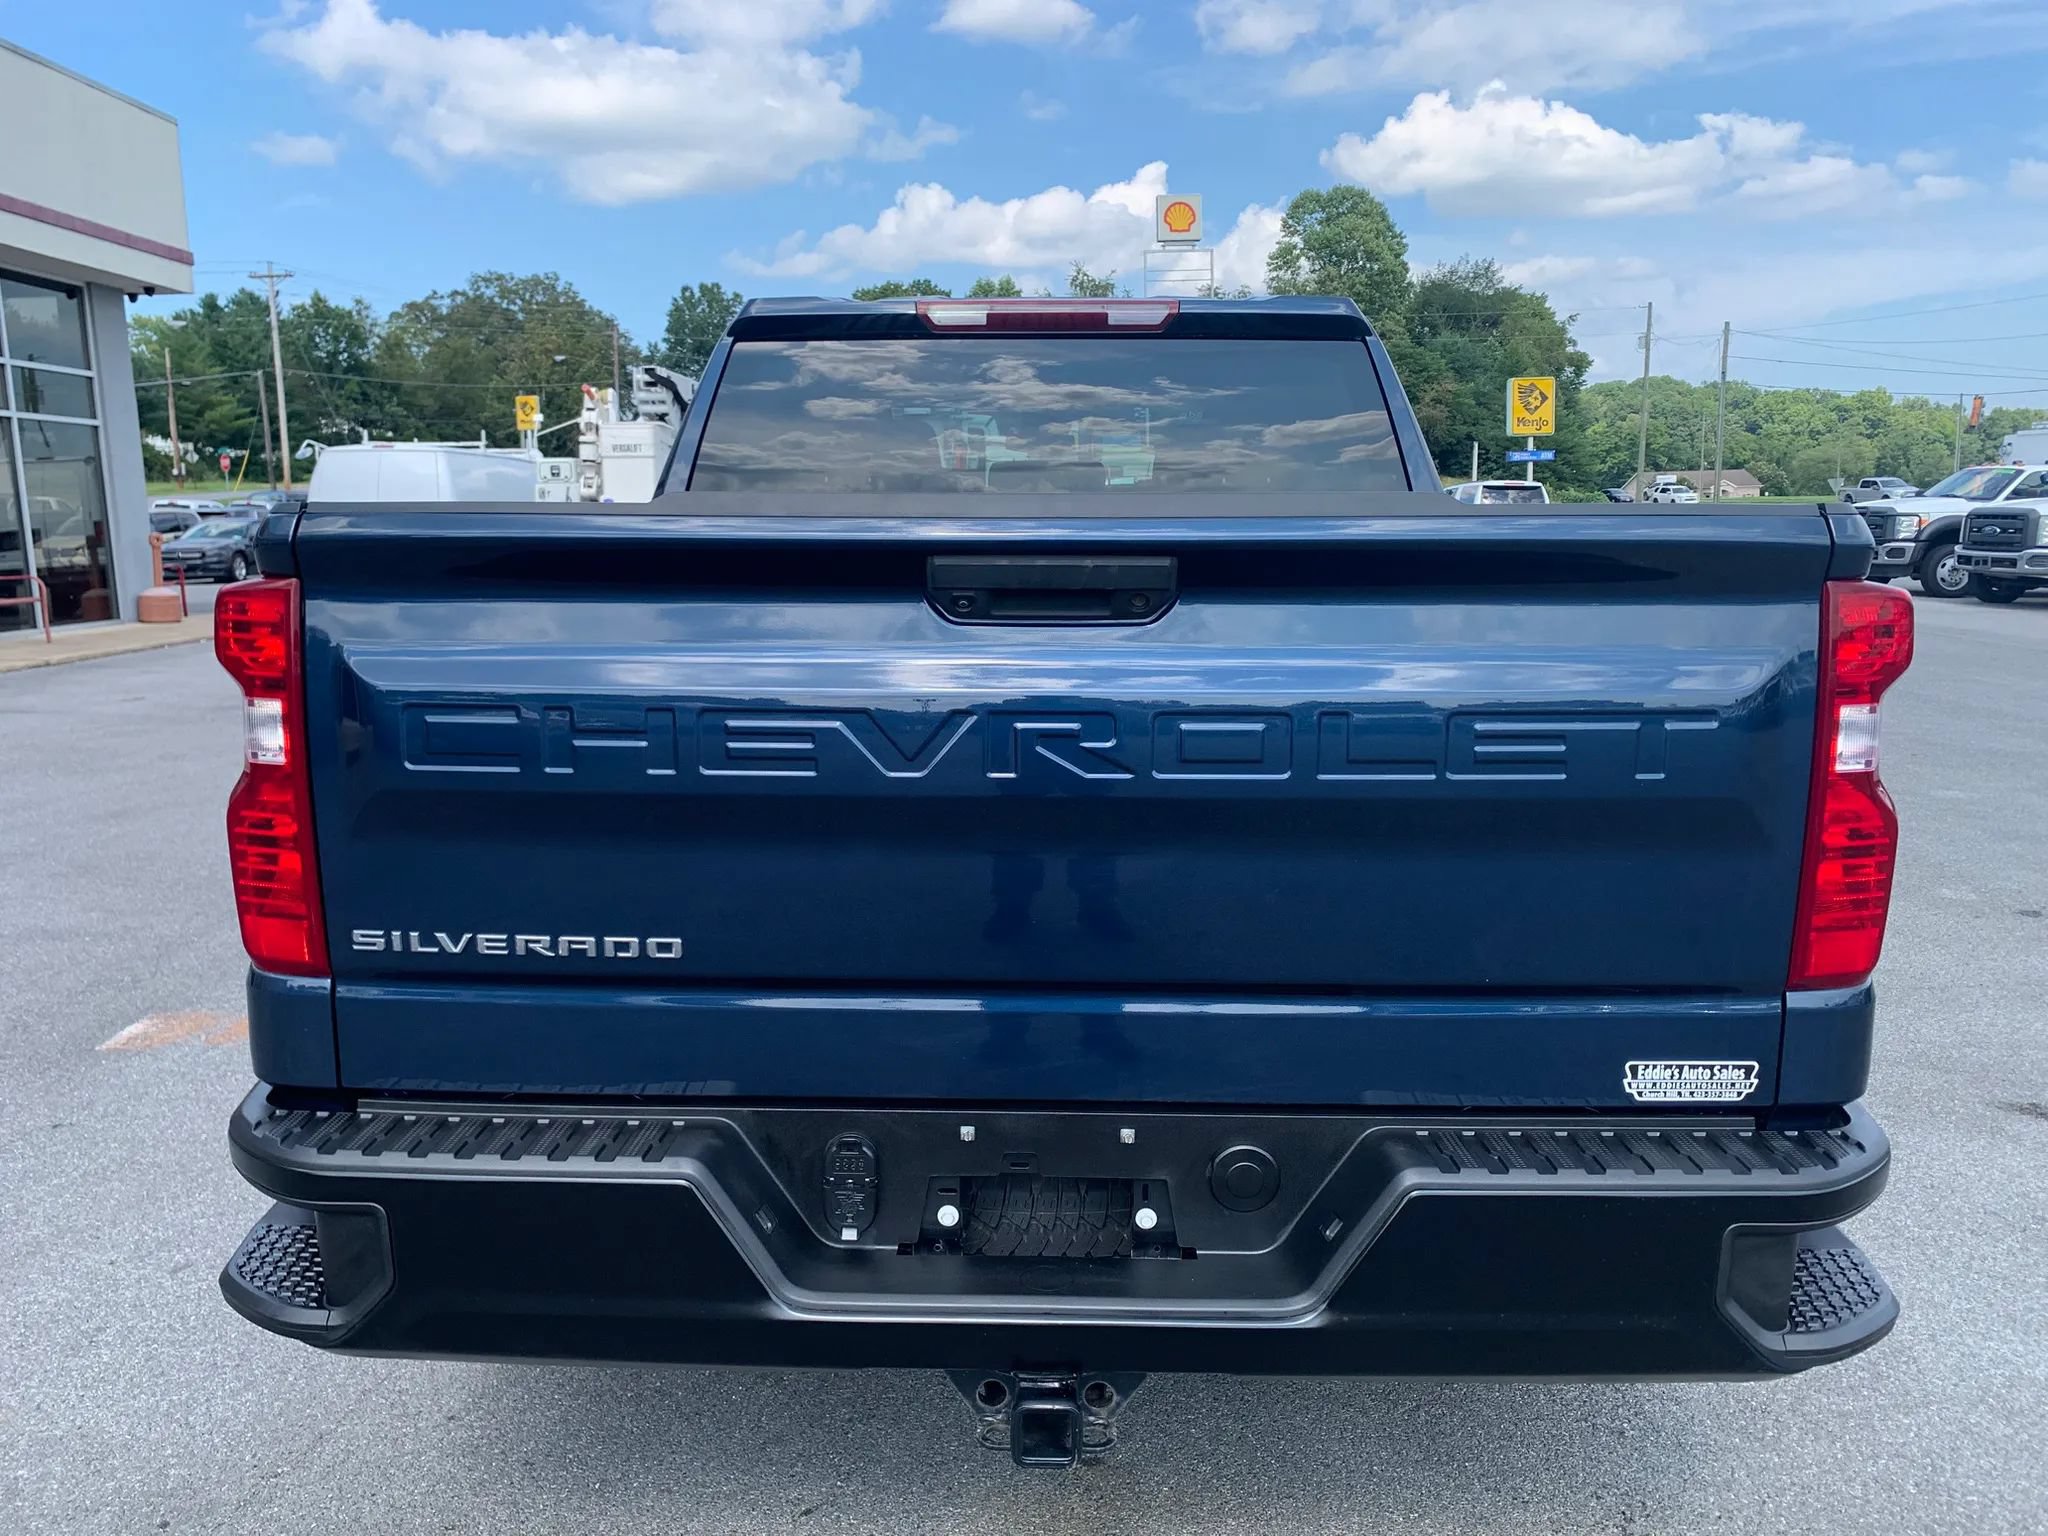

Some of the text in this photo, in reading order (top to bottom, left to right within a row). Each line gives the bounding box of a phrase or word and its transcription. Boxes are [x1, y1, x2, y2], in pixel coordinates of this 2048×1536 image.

[403, 704, 1719, 781] CHEVROLET
[352, 929, 683, 959] SILVERADO
[1637, 1065, 1746, 1080] Eddie's Auto Sales
[1631, 1082, 1750, 1090] WWW.EDDIESAUTOSALES.NET
[1642, 1090, 1665, 1098] Church
